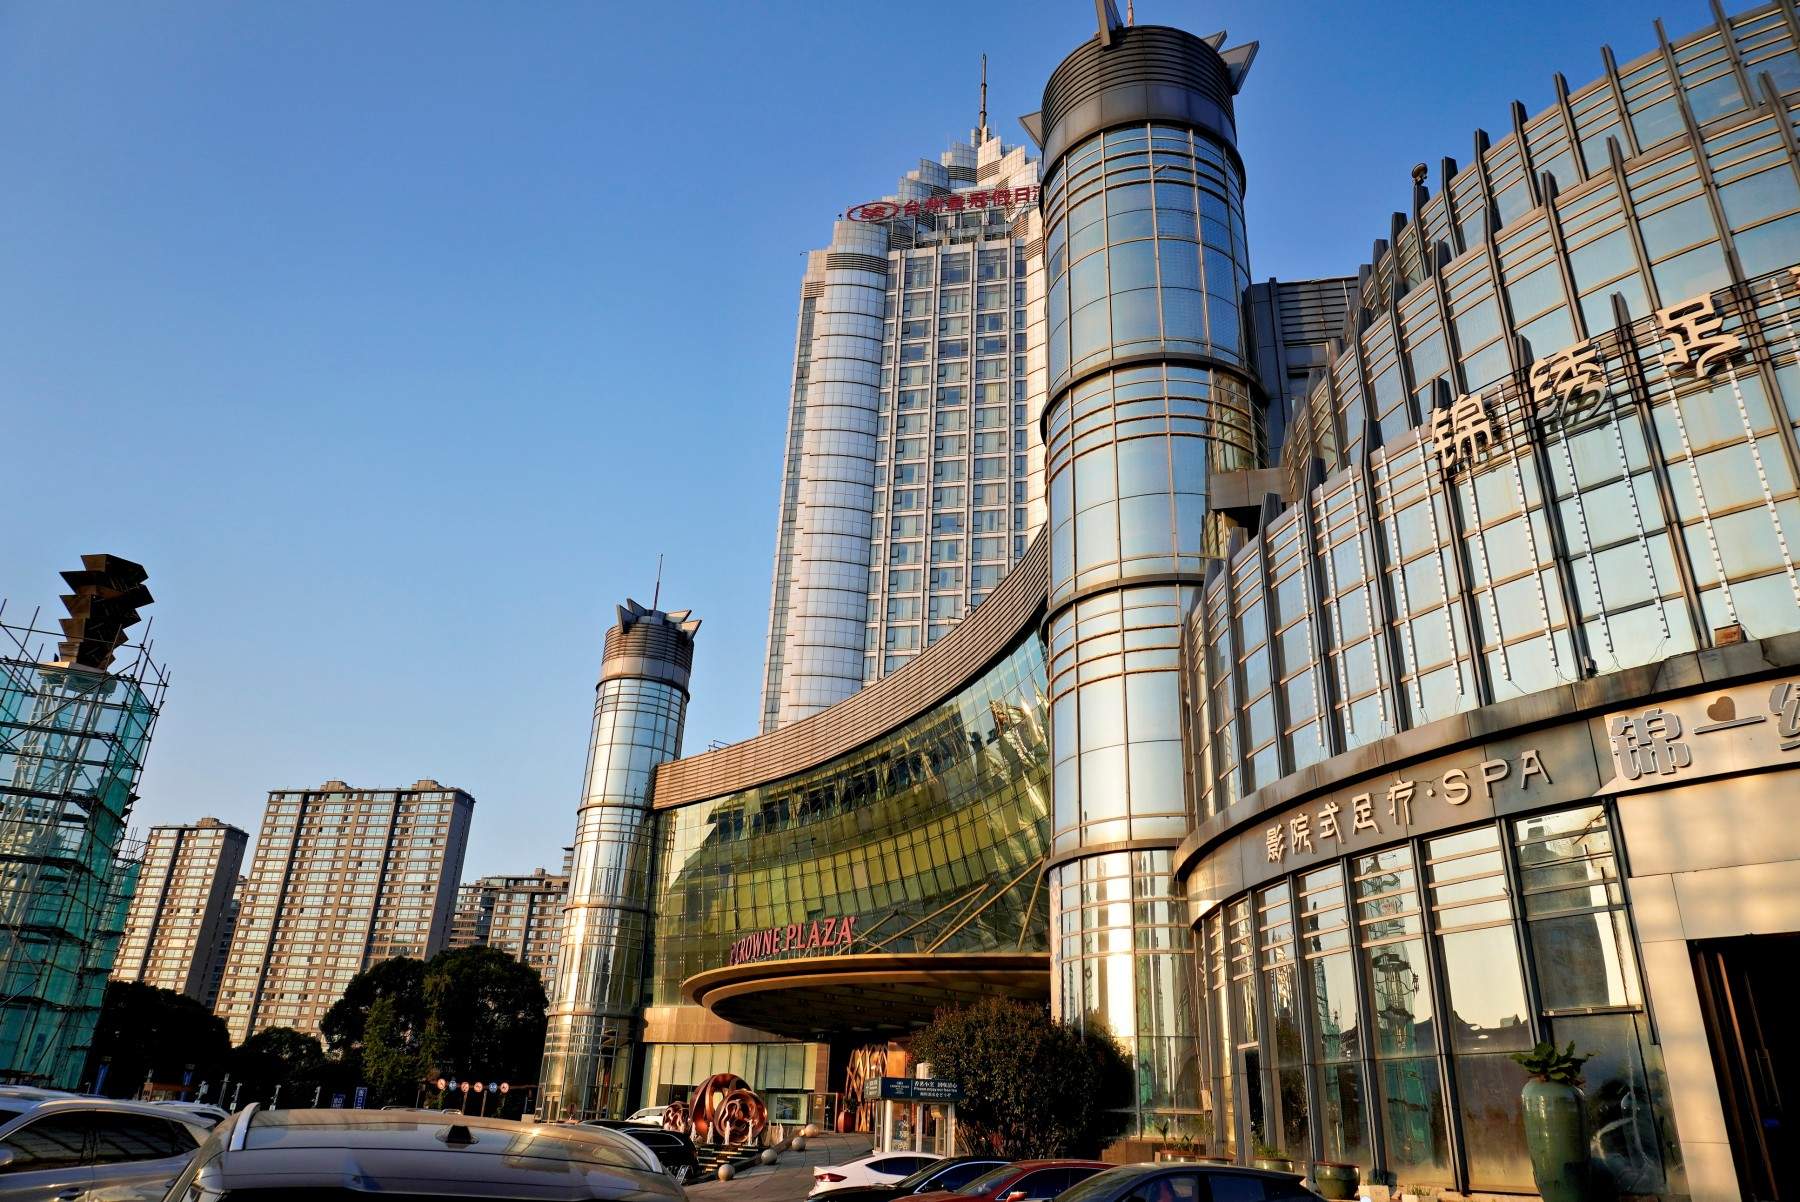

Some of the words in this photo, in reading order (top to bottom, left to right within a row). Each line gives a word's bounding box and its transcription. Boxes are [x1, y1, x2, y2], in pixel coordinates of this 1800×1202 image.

[1431, 266, 1800, 470] 锦绣足
[785, 916, 857, 951] PLAZA
